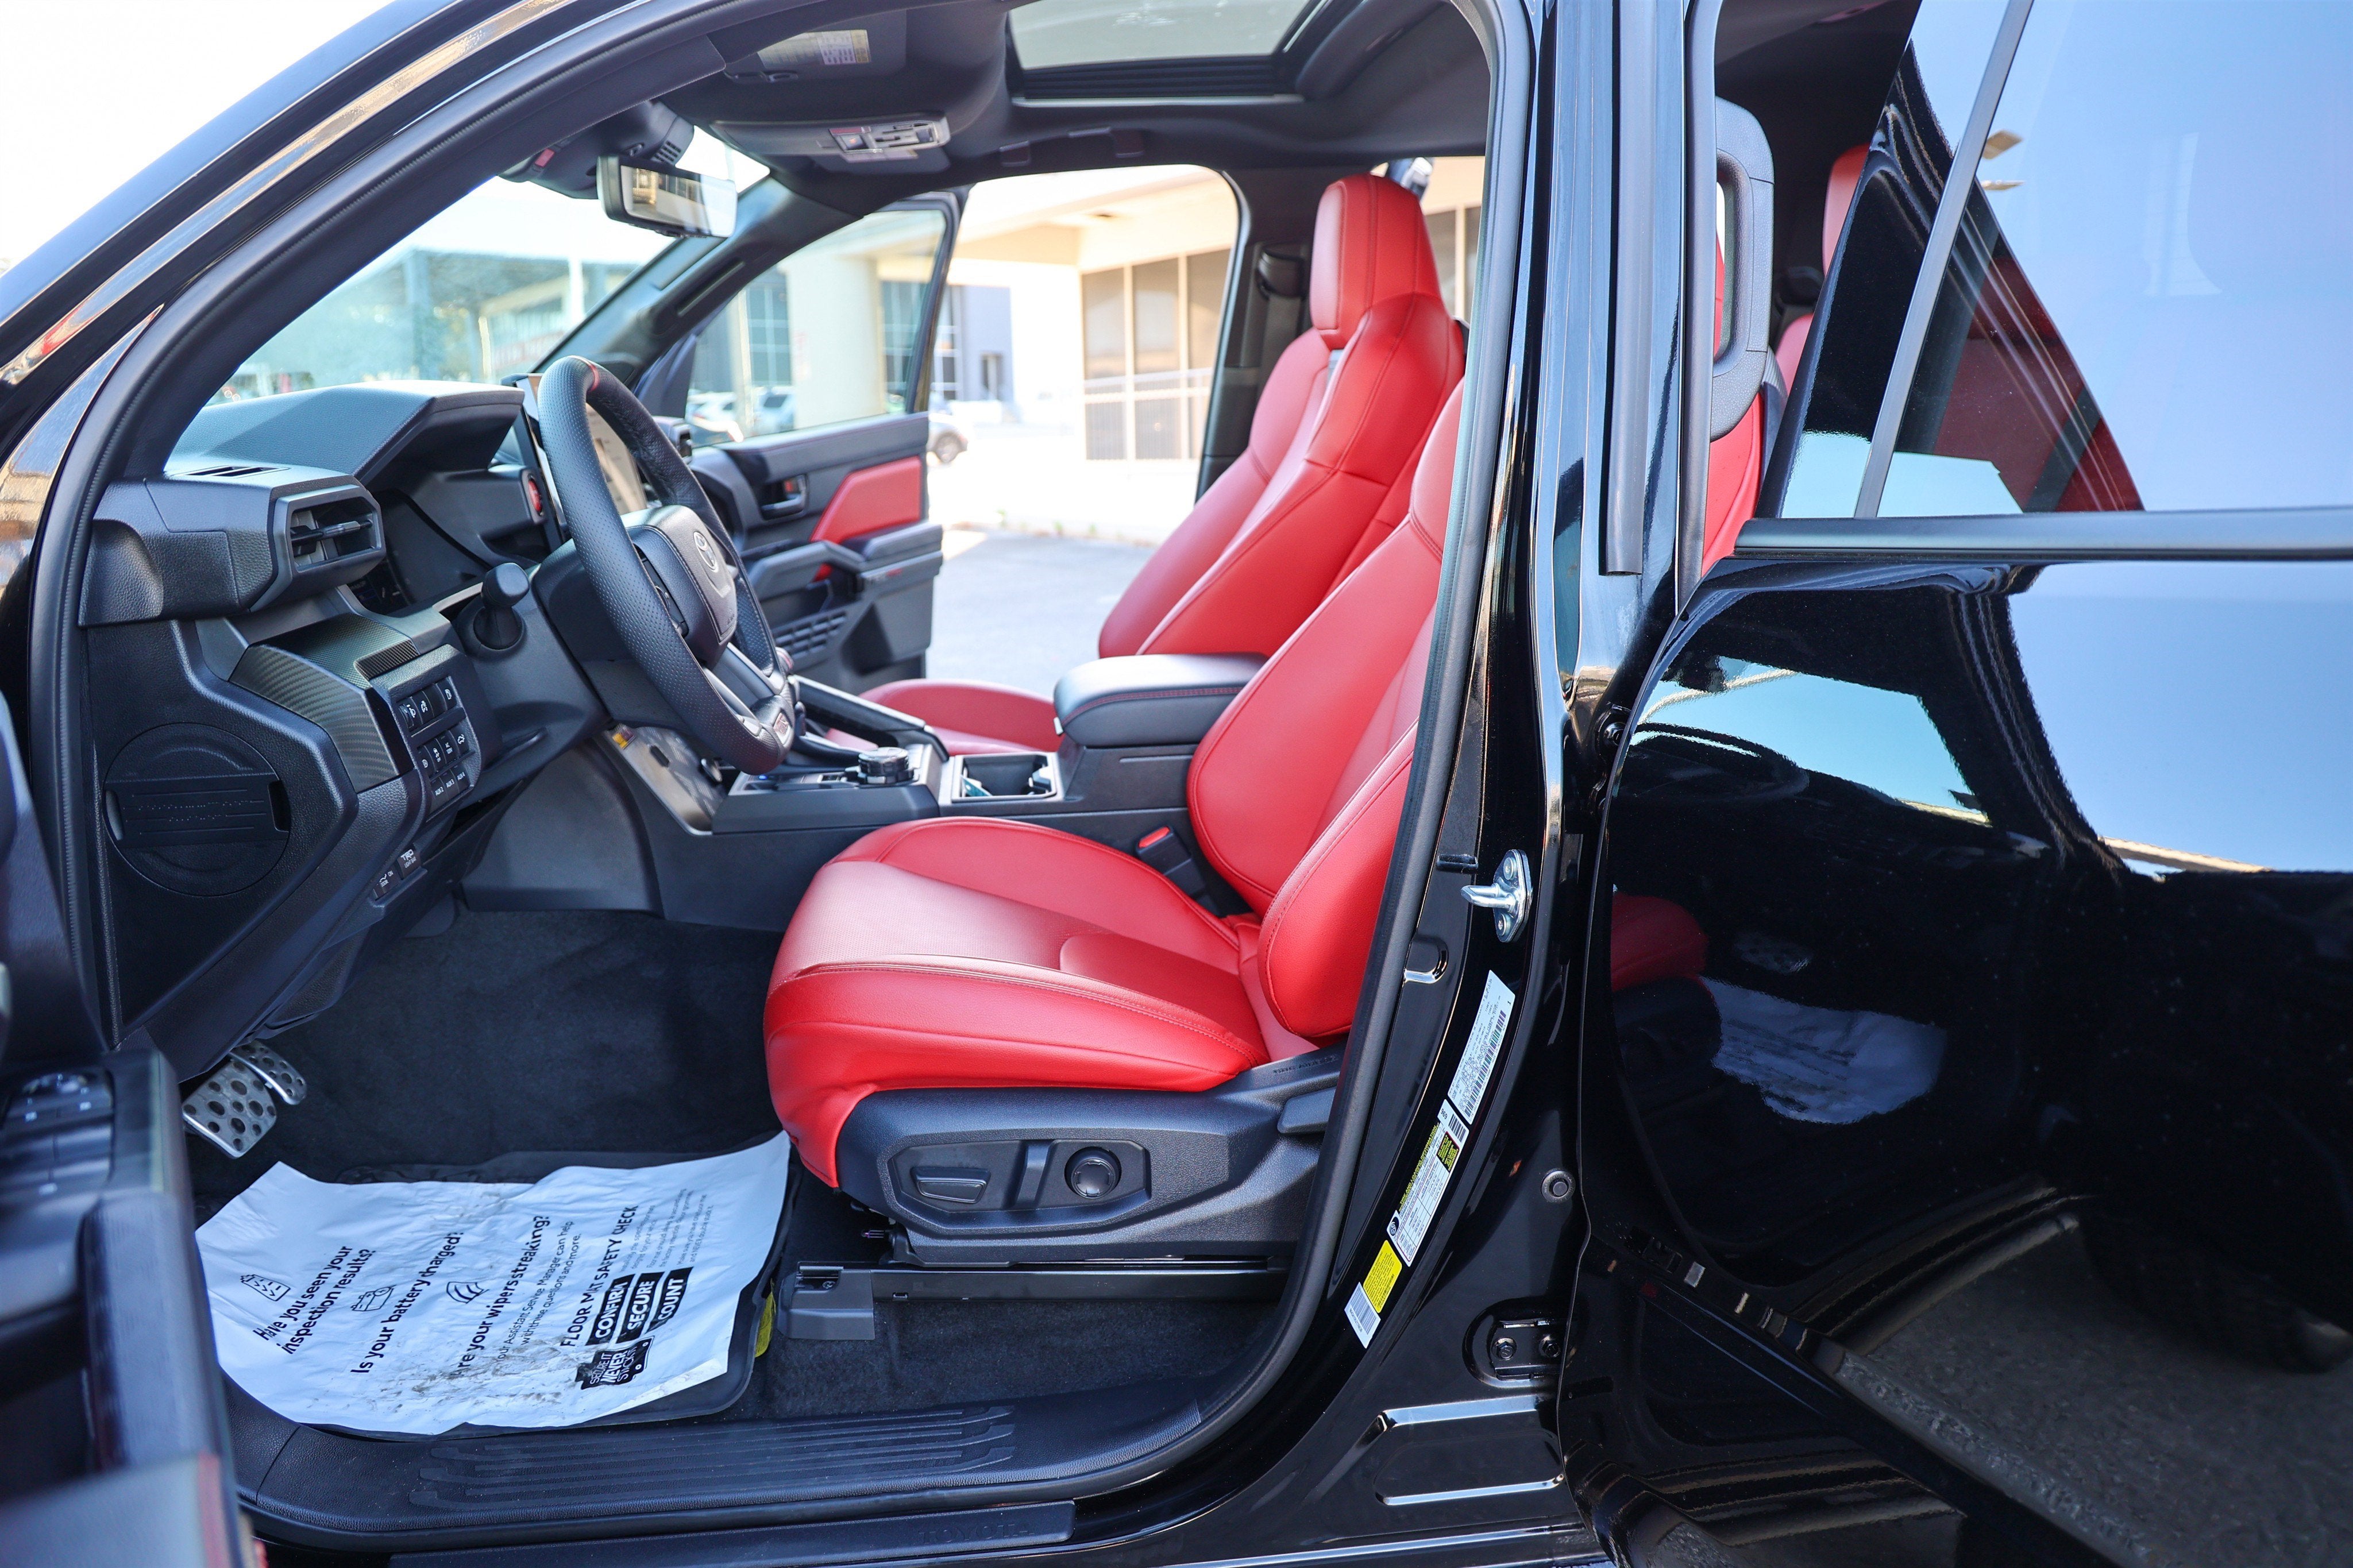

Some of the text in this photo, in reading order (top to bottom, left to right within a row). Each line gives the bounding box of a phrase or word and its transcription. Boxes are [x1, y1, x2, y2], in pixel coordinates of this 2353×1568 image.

[401, 849, 414, 860] TRD
[557, 1221, 574, 1236] help
[557, 1238, 565, 1256] can
[537, 1254, 561, 1285] Manager
[560, 1206, 638, 1346] FLOOR MAT SAFETY CHECK
[253, 1246, 352, 1341] Have you seen your
[277, 1249, 376, 1354] inspection results?
[350, 1233, 464, 1373] Is your battery charged?
[451, 1216, 550, 1377] Are your wipers streaking?
[522, 1288, 545, 1314] Service
[625, 1279, 656, 1331] SECURE
[657, 1277, 685, 1320] COUNT
[503, 1310, 530, 1344] Assistant
[593, 1283, 627, 1338] CONFIRM
[521, 1325, 536, 1345] with
[589, 1353, 612, 1384] SECURE IT
[600, 1350, 628, 1383] NEVER
[918, 1523, 1035, 1544] TOYOTA
